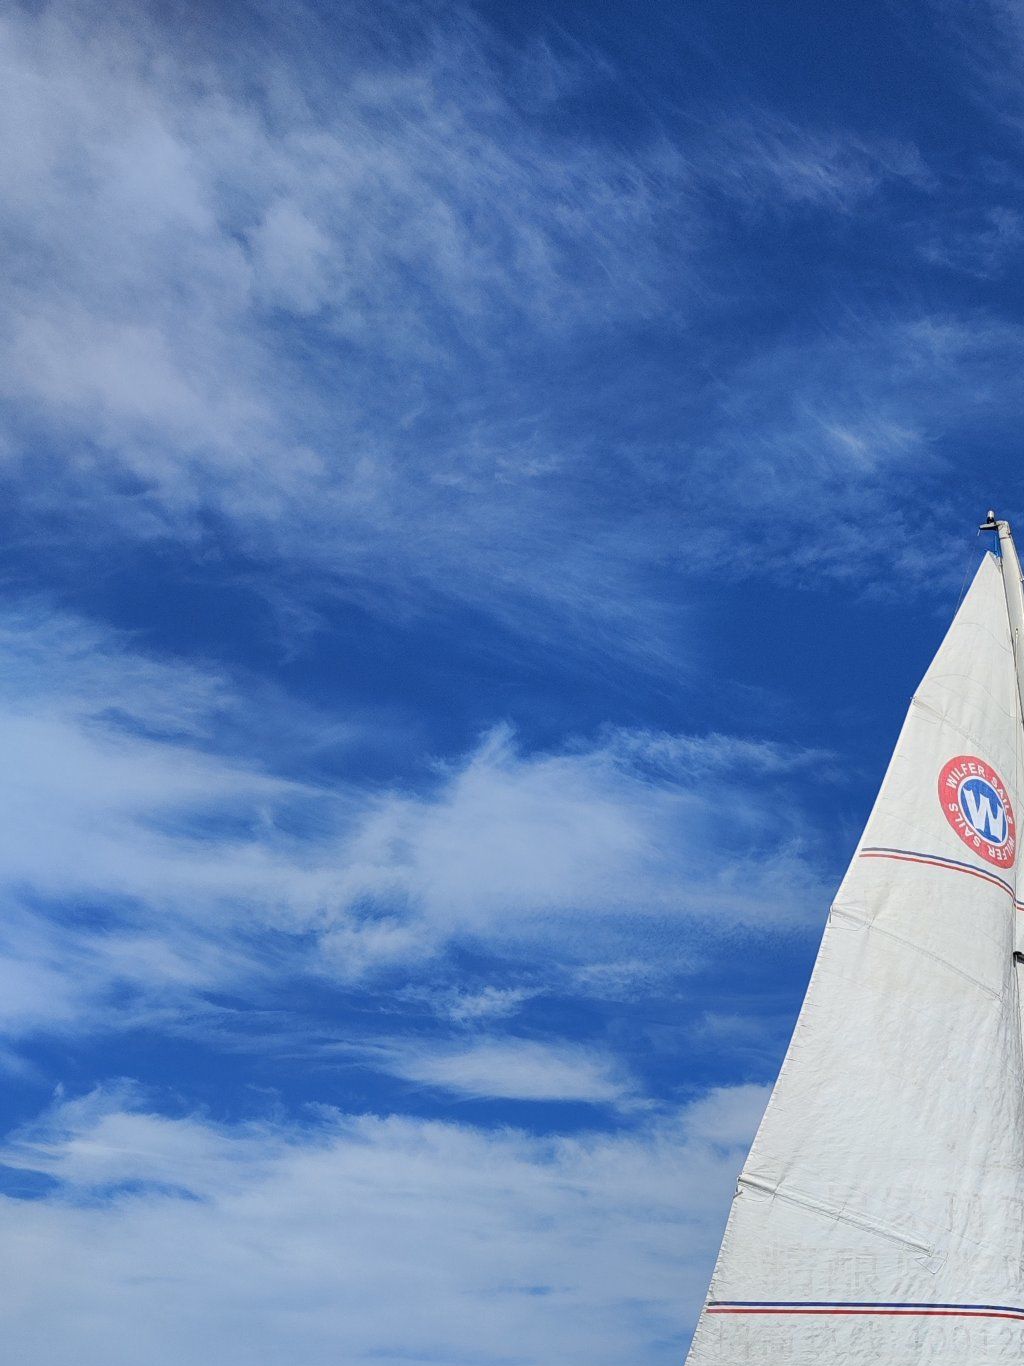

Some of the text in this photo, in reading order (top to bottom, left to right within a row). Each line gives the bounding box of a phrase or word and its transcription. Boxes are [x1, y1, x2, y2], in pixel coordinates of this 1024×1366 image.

[945, 763, 986, 790] WILFER
[948, 803, 982, 848] SAILS
[962, 786, 1005, 843] W
